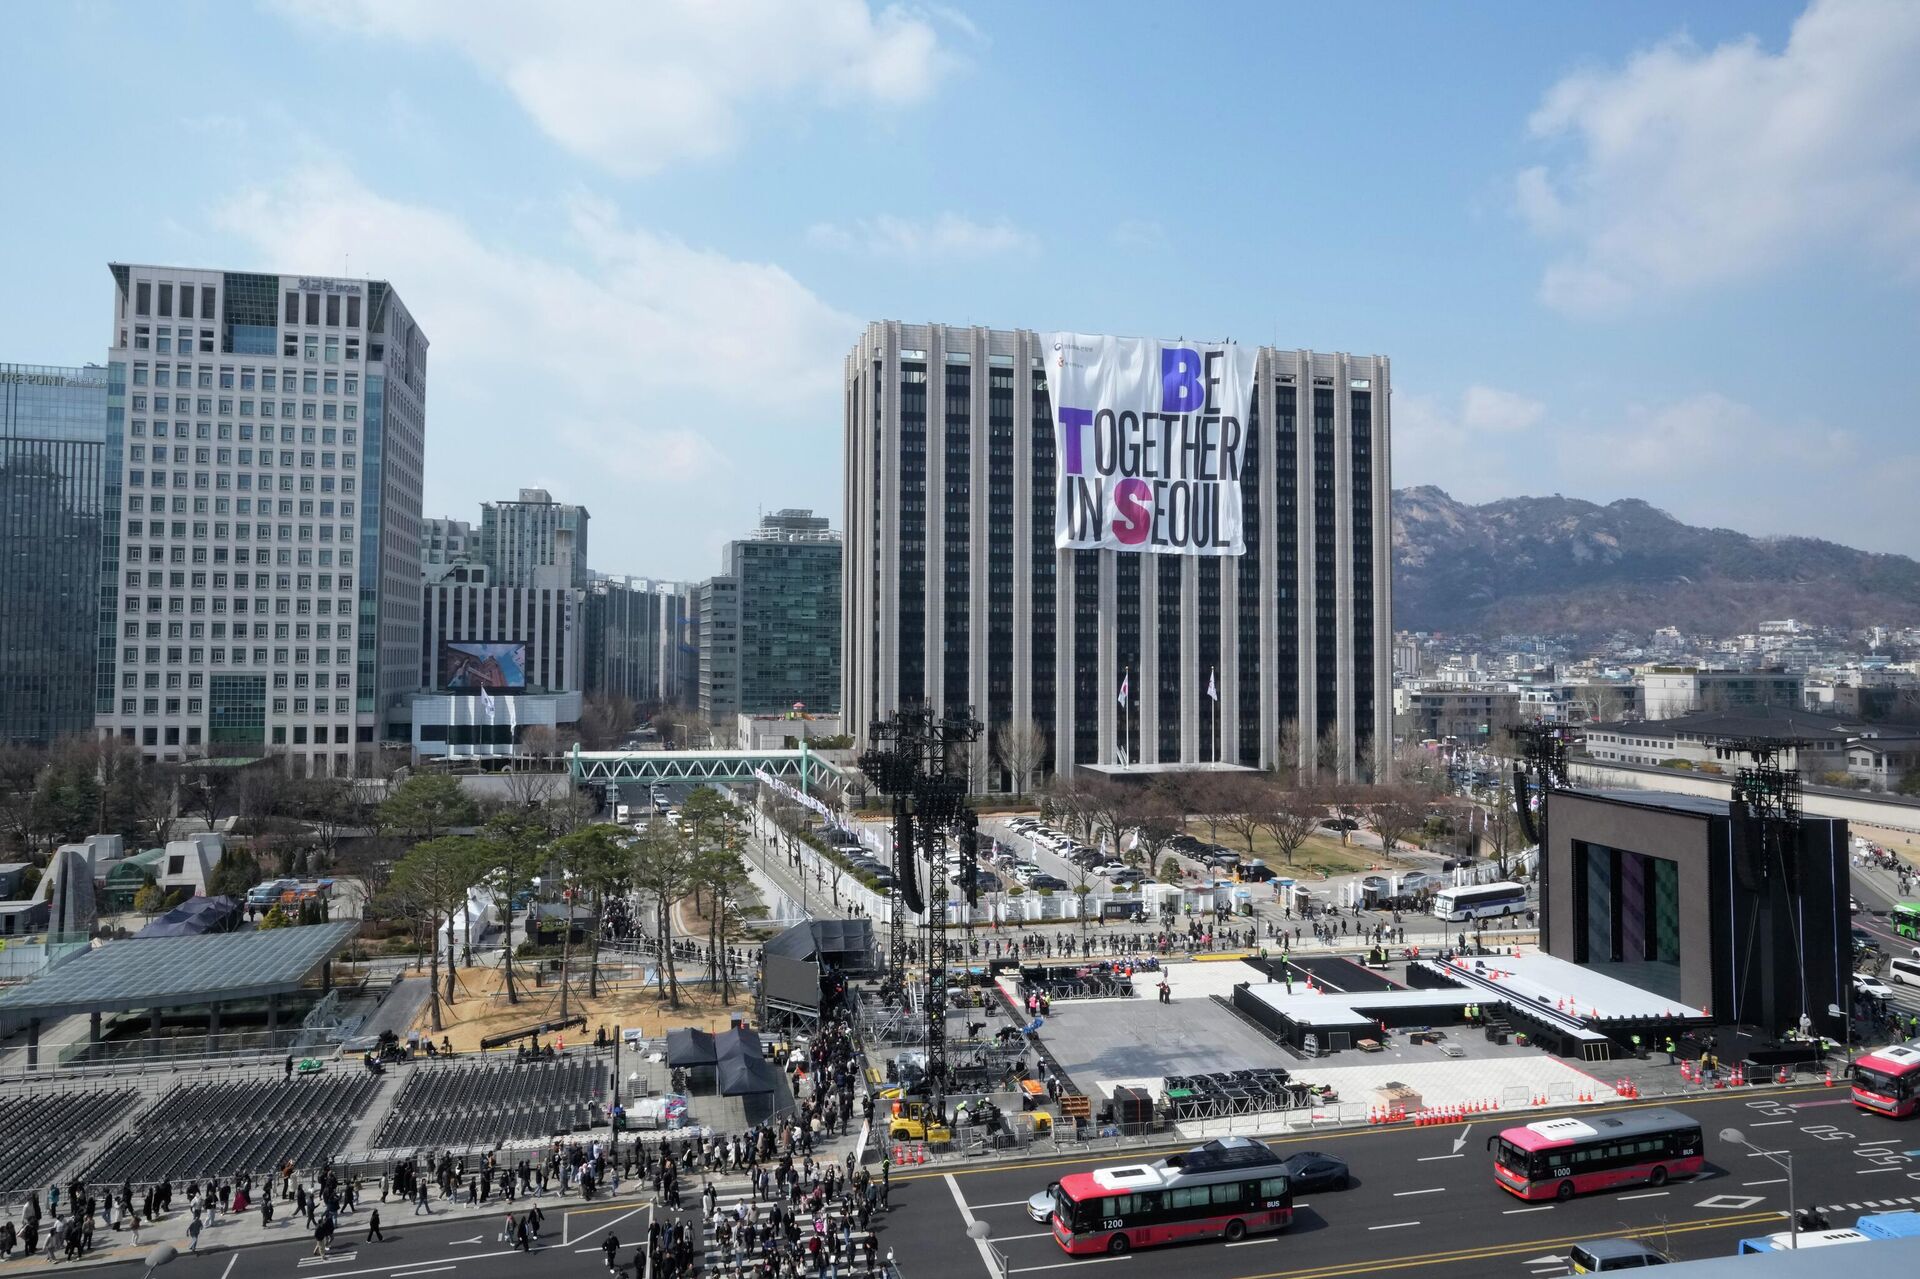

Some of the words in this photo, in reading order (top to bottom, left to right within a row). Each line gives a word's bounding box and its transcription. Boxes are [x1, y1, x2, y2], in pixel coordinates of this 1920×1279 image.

[1162, 348, 1224, 414] BE
[1059, 406, 1241, 481] TOGETHER
[1067, 476, 1103, 542] IN
[1112, 478, 1231, 548] SEOUL
[1683, 1148, 1694, 1156] BUS
[1553, 1168, 1571, 1177] 1000
[1267, 1200, 1280, 1208] BUS
[1103, 1219, 1123, 1229] 1200
